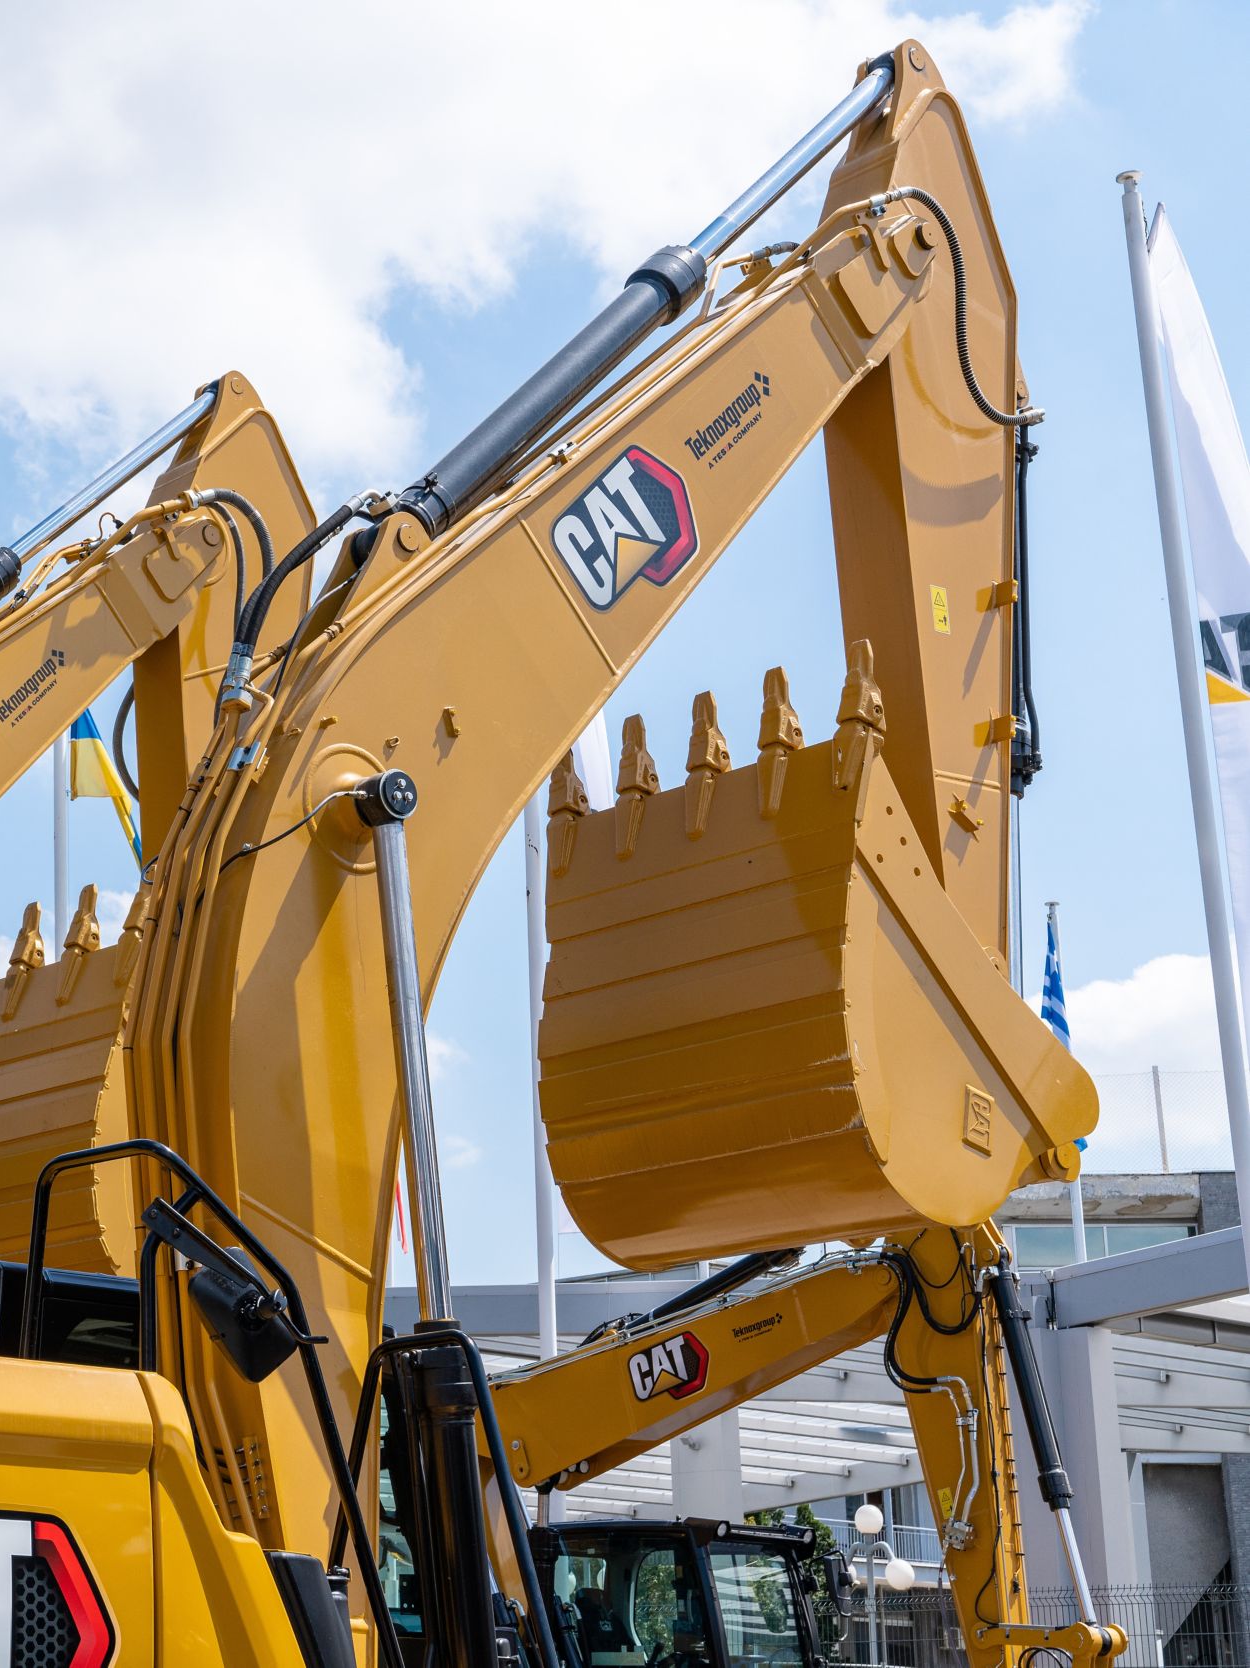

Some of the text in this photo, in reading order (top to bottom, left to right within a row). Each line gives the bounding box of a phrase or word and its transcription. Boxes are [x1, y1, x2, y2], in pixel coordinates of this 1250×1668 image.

[684, 383, 761, 461] Teknoxgroup
[733, 411, 762, 444] COMPANY
[553, 456, 667, 606] CAT
[32, 679, 58, 706] COMPANY
[969, 1092, 992, 1149] CAT
[629, 1335, 689, 1400] CAT
